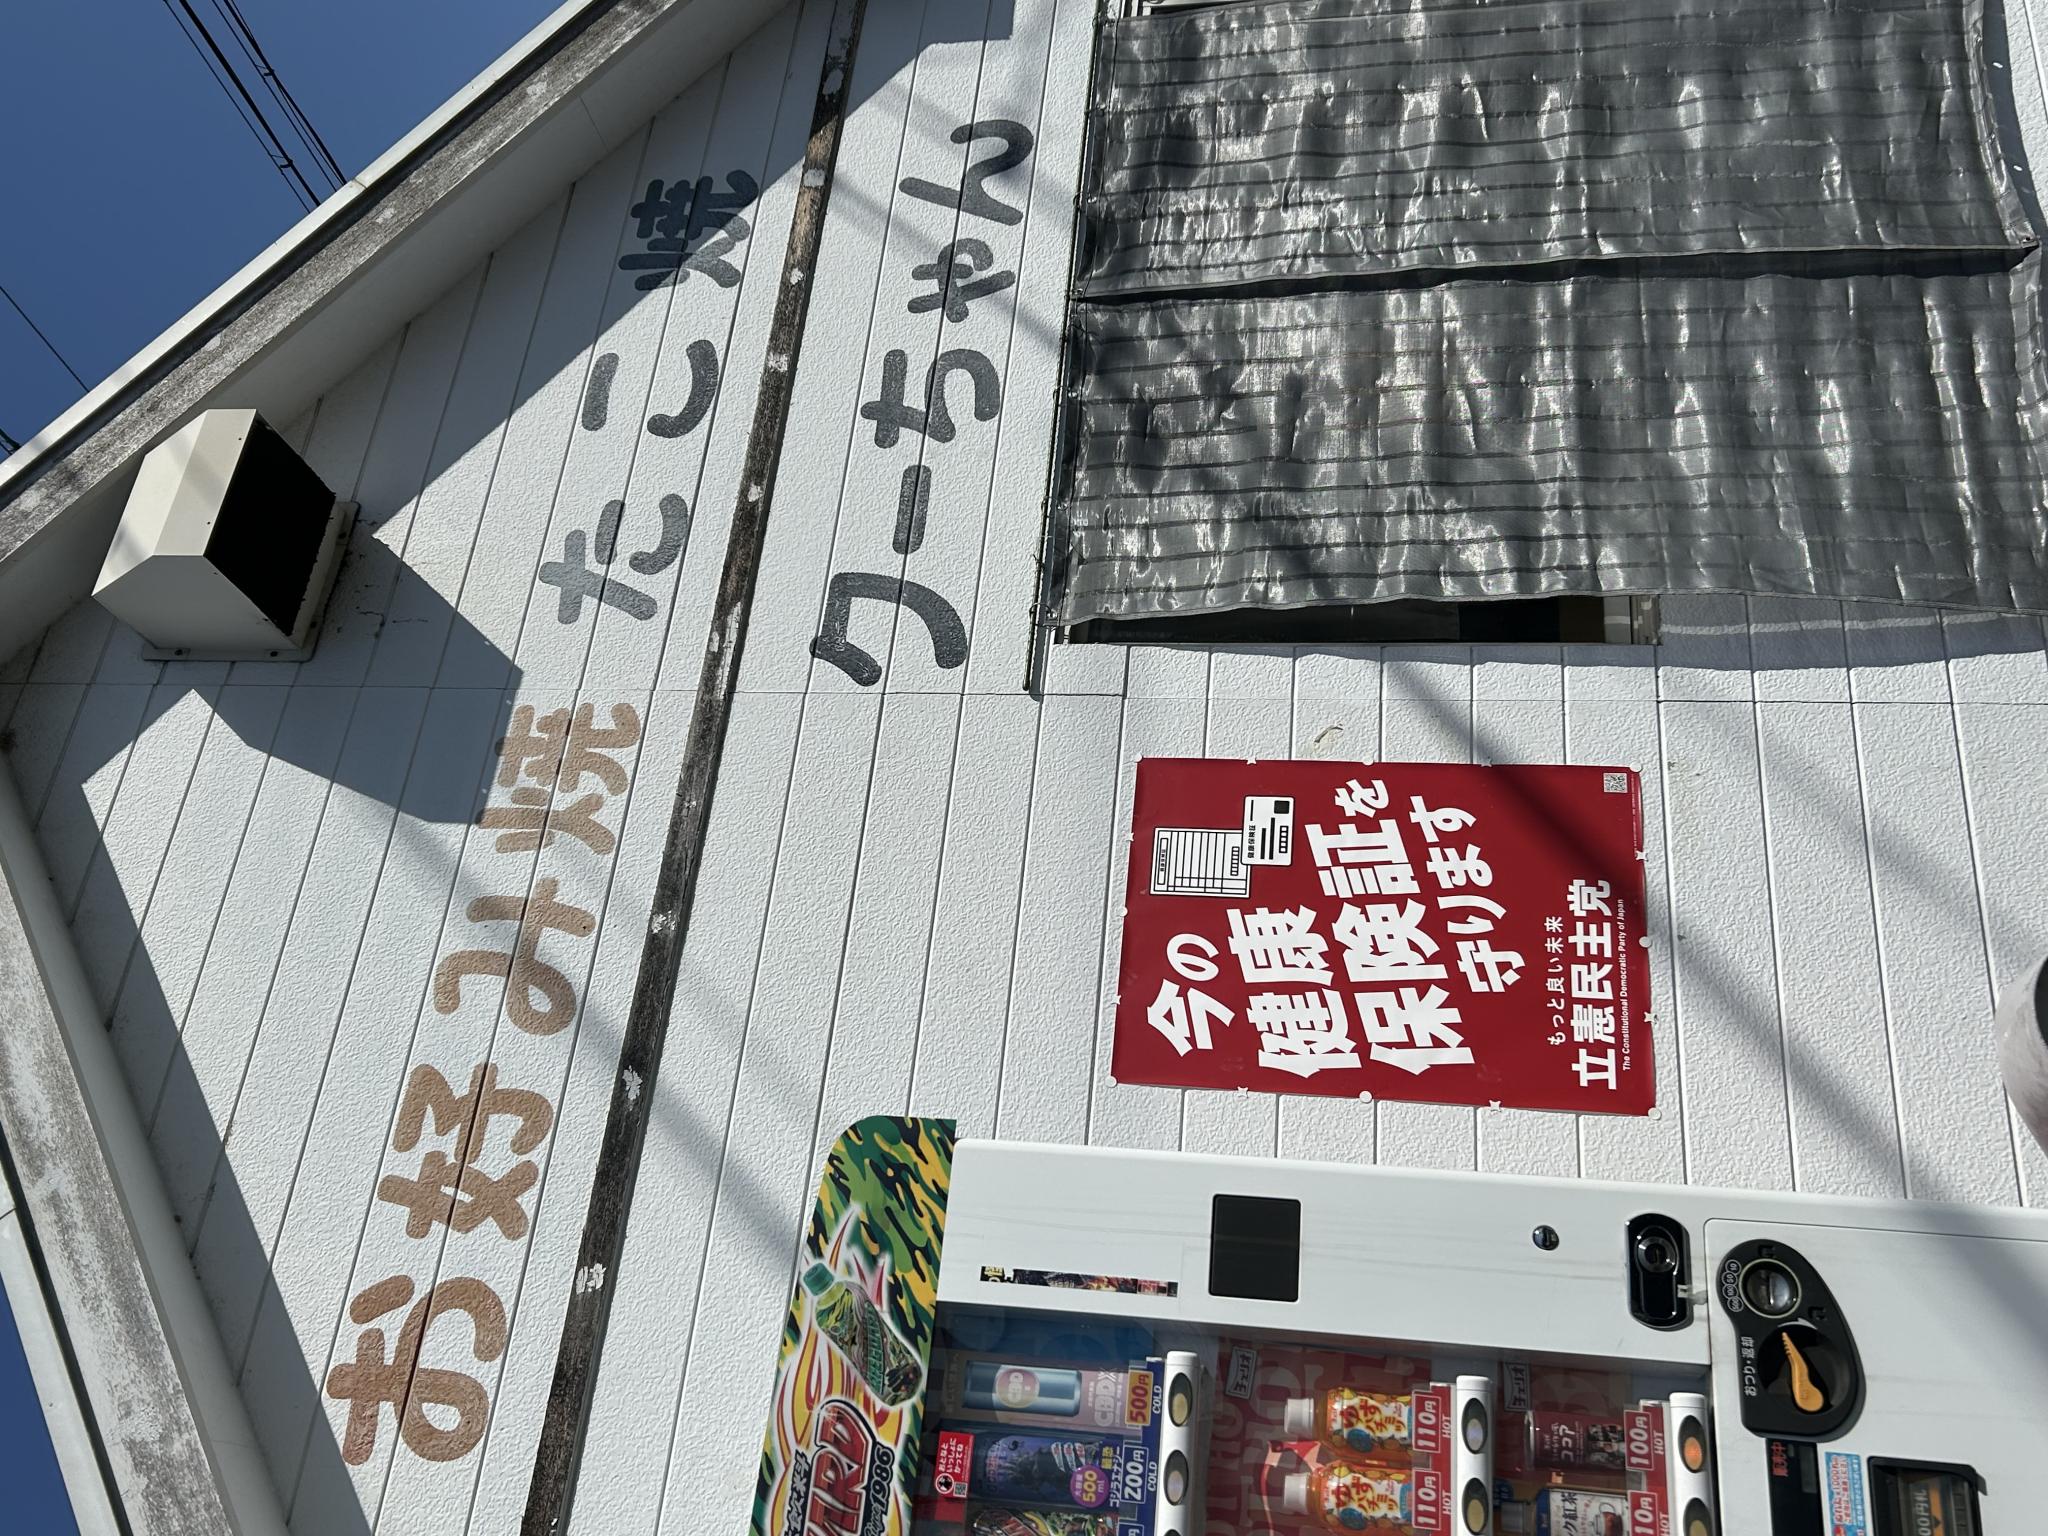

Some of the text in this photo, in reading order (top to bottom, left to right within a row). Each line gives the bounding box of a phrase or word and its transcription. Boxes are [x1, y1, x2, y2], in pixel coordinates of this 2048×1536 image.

[809, 120, 1033, 687] クーちゃん
[326, 170, 759, 1466] お好み焼 たこ焼
[1409, 795, 1525, 993] 守ります
[1305, 778, 1476, 1076] 保険証を
[1147, 932, 1236, 1056] 今の
[1226, 905, 1361, 1078] 健康
[1543, 916, 1566, 1046] もっと良い未来
[1567, 879, 1616, 1090] 立憲民主党
[1616, 899, 1631, 1071] The Constitutional Democratic Party of Japan
[1741, 1336, 1757, 1397] おつり・返却
[1129, 1374, 1149, 1424] 500円
[1152, 1385, 1162, 1414] COLD
[1339, 1398, 1381, 1428] ゆず
[1365, 1415, 1405, 1433] ハチミツ
[1417, 1400, 1436, 1448] 110円
[1442, 1414, 1451, 1438] HOT
[1559, 1424, 1576, 1462] ココア
[1630, 1416, 1649, 1465] 100円
[1653, 1430, 1664, 1455] HOT
[806, 1405, 868, 1536] ARD
[870, 1446, 893, 1509] 1986
[938, 1442, 949, 1472] おとなと
[946, 1437, 957, 1473] いっしょに
[954, 1443, 963, 1474] かってね
[1124, 1450, 1145, 1501] 200円
[1147, 1461, 1157, 1492] COLD
[1083, 1470, 1097, 1503] 500
[1332, 1476, 1374, 1508] ゆず
[1357, 1493, 1398, 1513] ハチミツ
[1417, 1476, 1436, 1525] 110円
[1442, 1490, 1451, 1515] HOT
